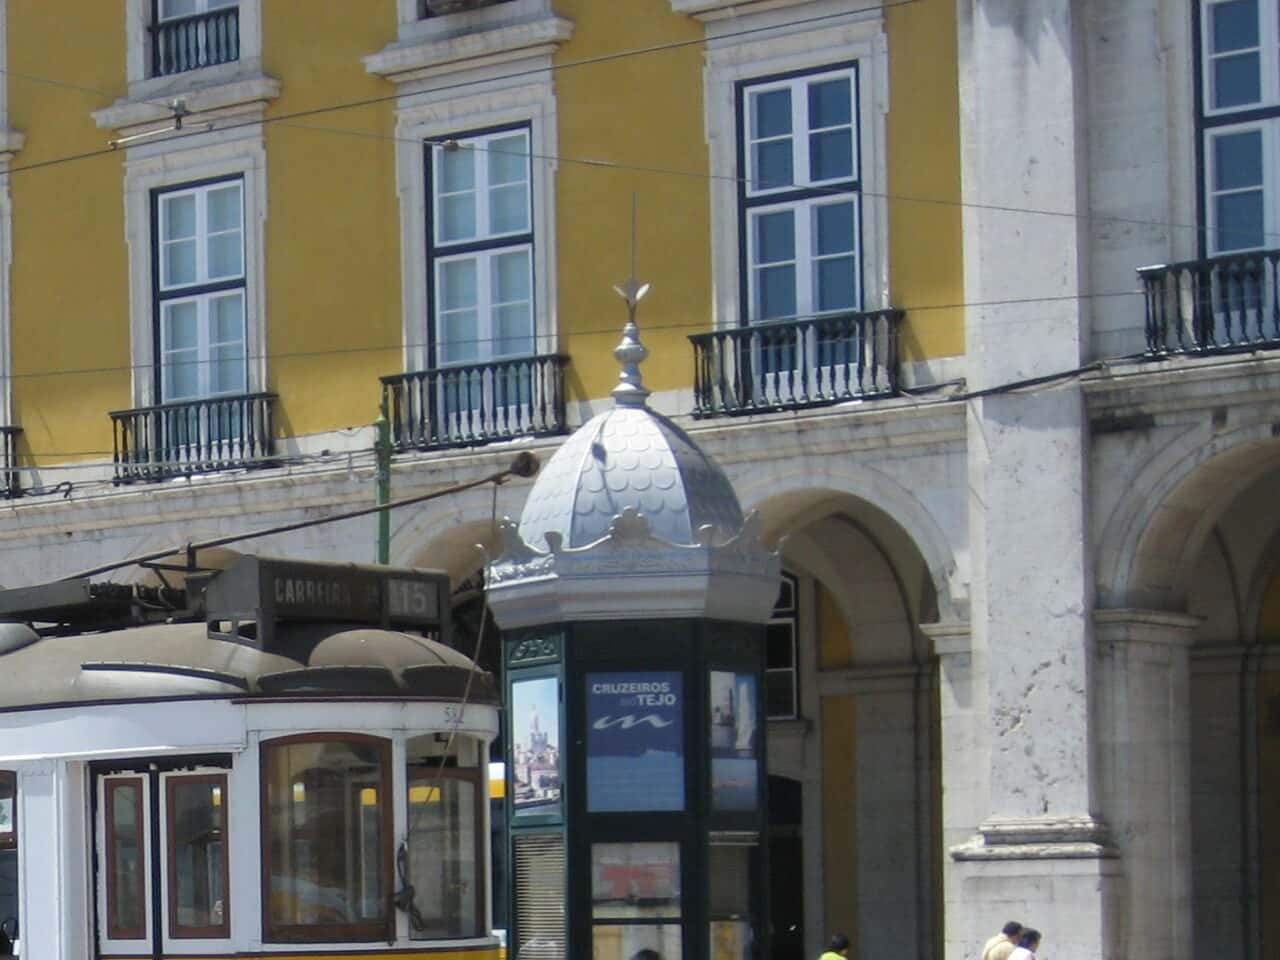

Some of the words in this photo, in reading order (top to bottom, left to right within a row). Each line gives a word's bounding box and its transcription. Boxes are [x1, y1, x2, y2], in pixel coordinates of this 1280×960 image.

[399, 582, 427, 614] 15
[592, 682, 671, 694] CRUZEIROS
[636, 693, 677, 706] TEJO
